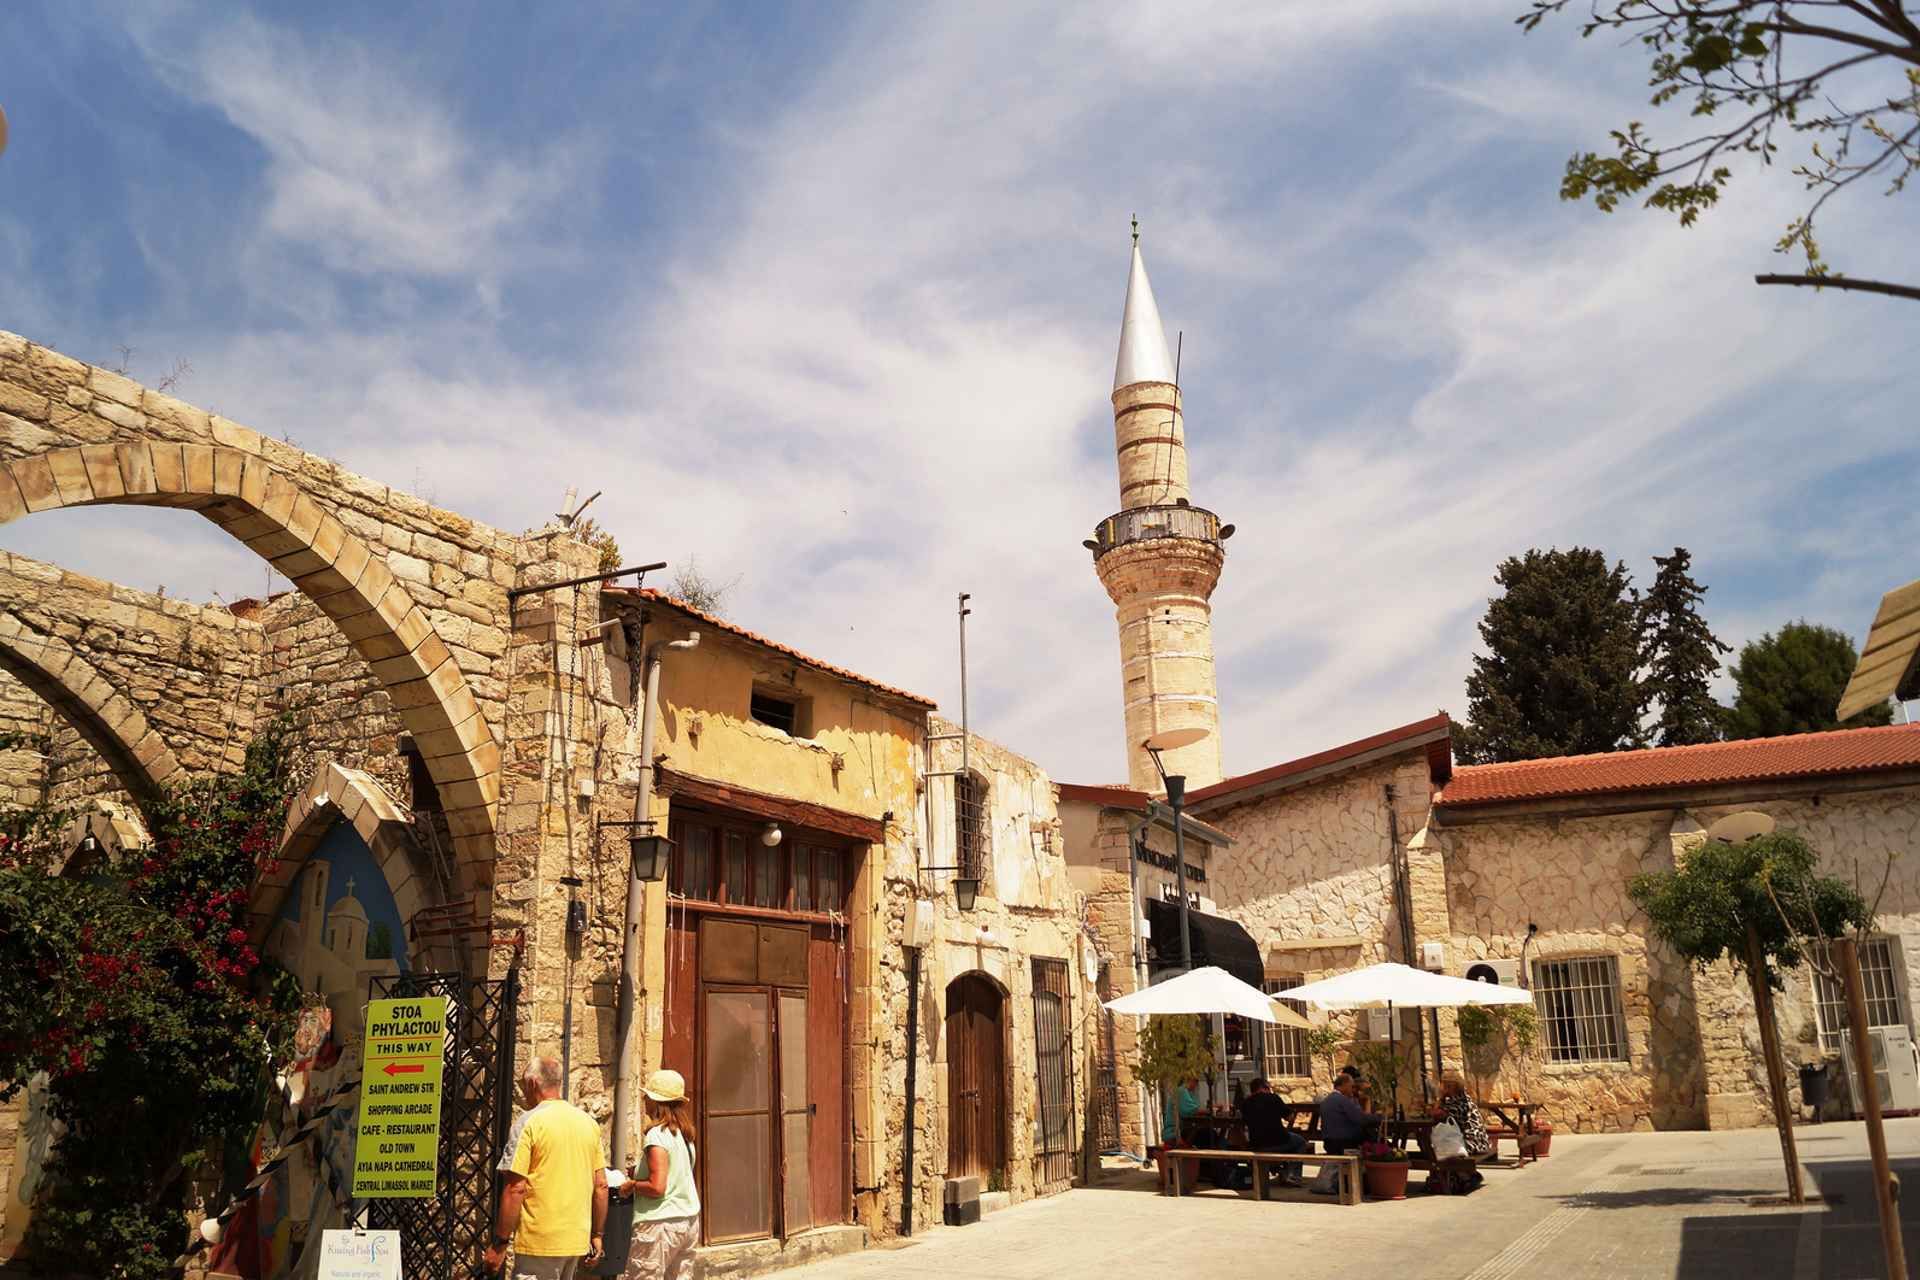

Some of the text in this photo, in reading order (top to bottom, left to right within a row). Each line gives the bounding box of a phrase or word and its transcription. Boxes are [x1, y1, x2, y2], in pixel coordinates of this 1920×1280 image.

[392, 1006, 422, 1019] STOA
[372, 1021, 441, 1036] PHYLACTOU
[377, 1042, 432, 1054] THIS WAY
[369, 1083, 435, 1095] SAINT ANDREW STR
[368, 1104, 433, 1116] SHOPPING ARCADE
[362, 1125, 381, 1135] CAFE
[387, 1123, 436, 1135] RESTAURANT
[379, 1143, 416, 1154] OLD TOWN
[358, 1160, 434, 1172] AYIA NAPA CATHEDRAL
[356, 1180, 434, 1191] CENTRAL LIMASSOL MARKET
